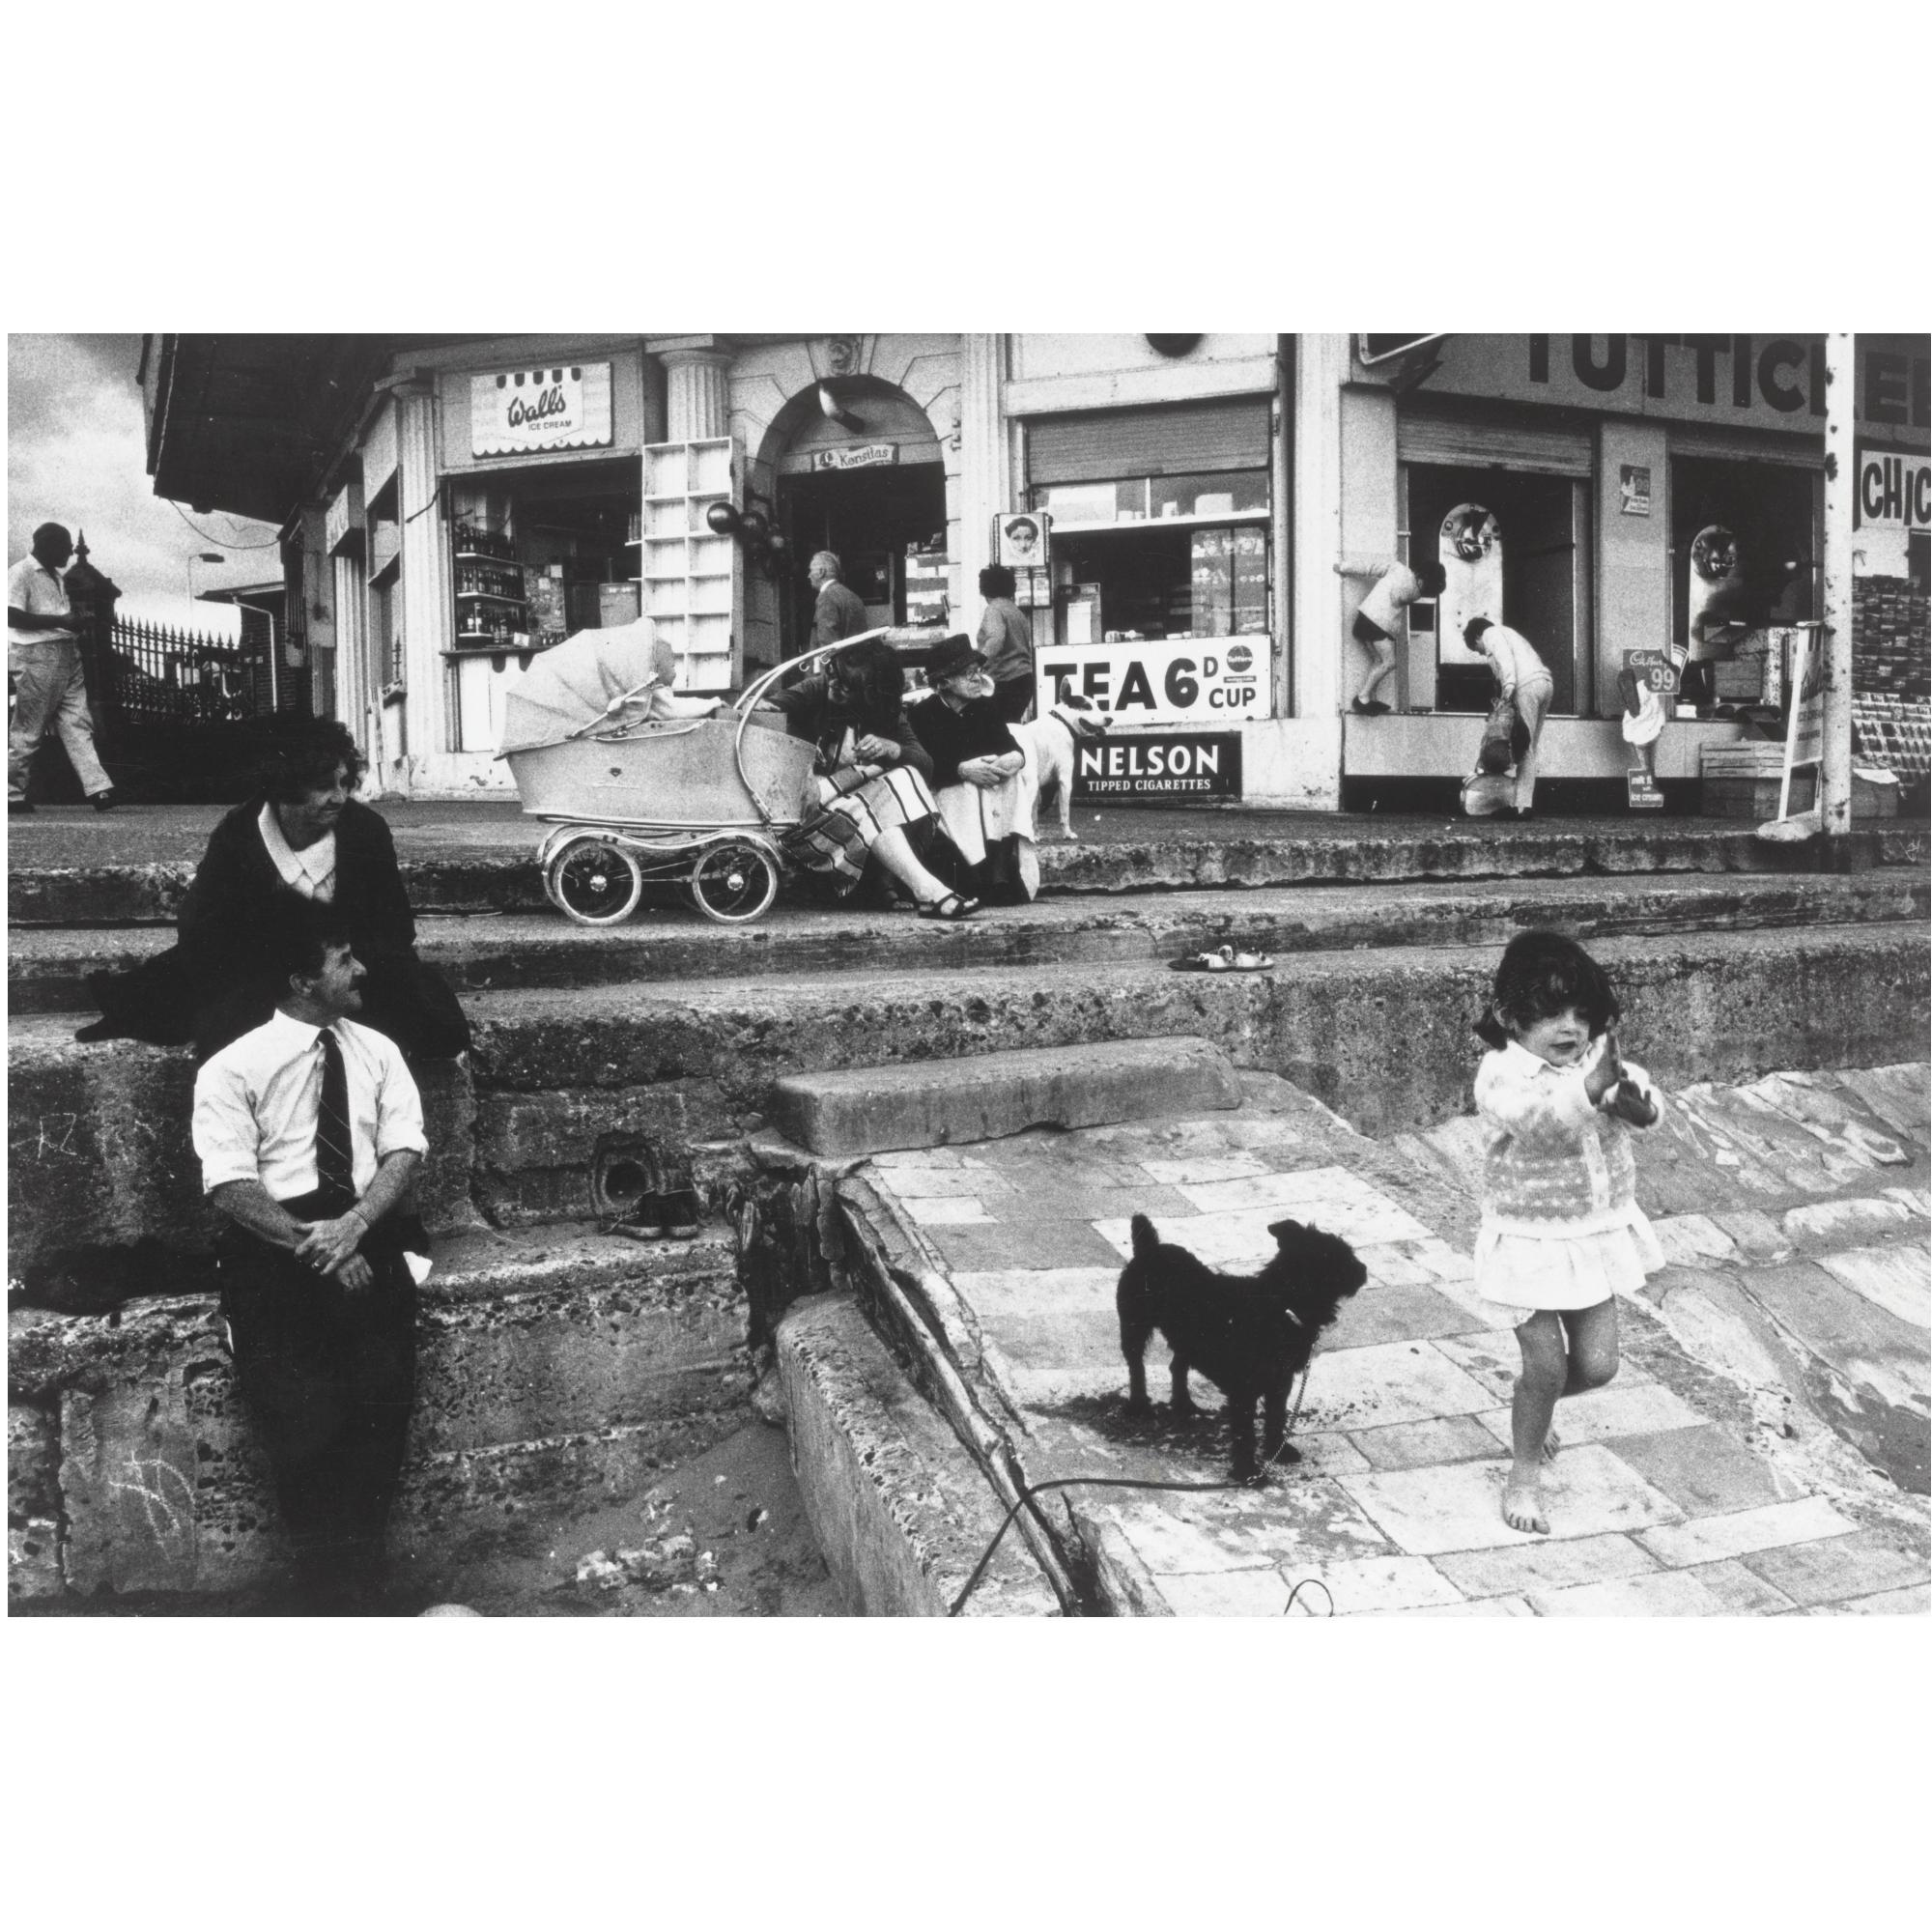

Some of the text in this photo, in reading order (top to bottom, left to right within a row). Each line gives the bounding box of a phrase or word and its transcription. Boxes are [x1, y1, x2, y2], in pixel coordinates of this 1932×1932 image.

[507, 384, 567, 428] Wall's
[528, 419, 572, 431] ICE CREAM
[1862, 457, 1931, 526] CHIC
[1044, 661, 1157, 712] TEA
[1209, 687, 1256, 709] CUP
[1081, 745, 1219, 777] NELSON
[1088, 779, 1211, 792] TIPPED CIGARETTES
